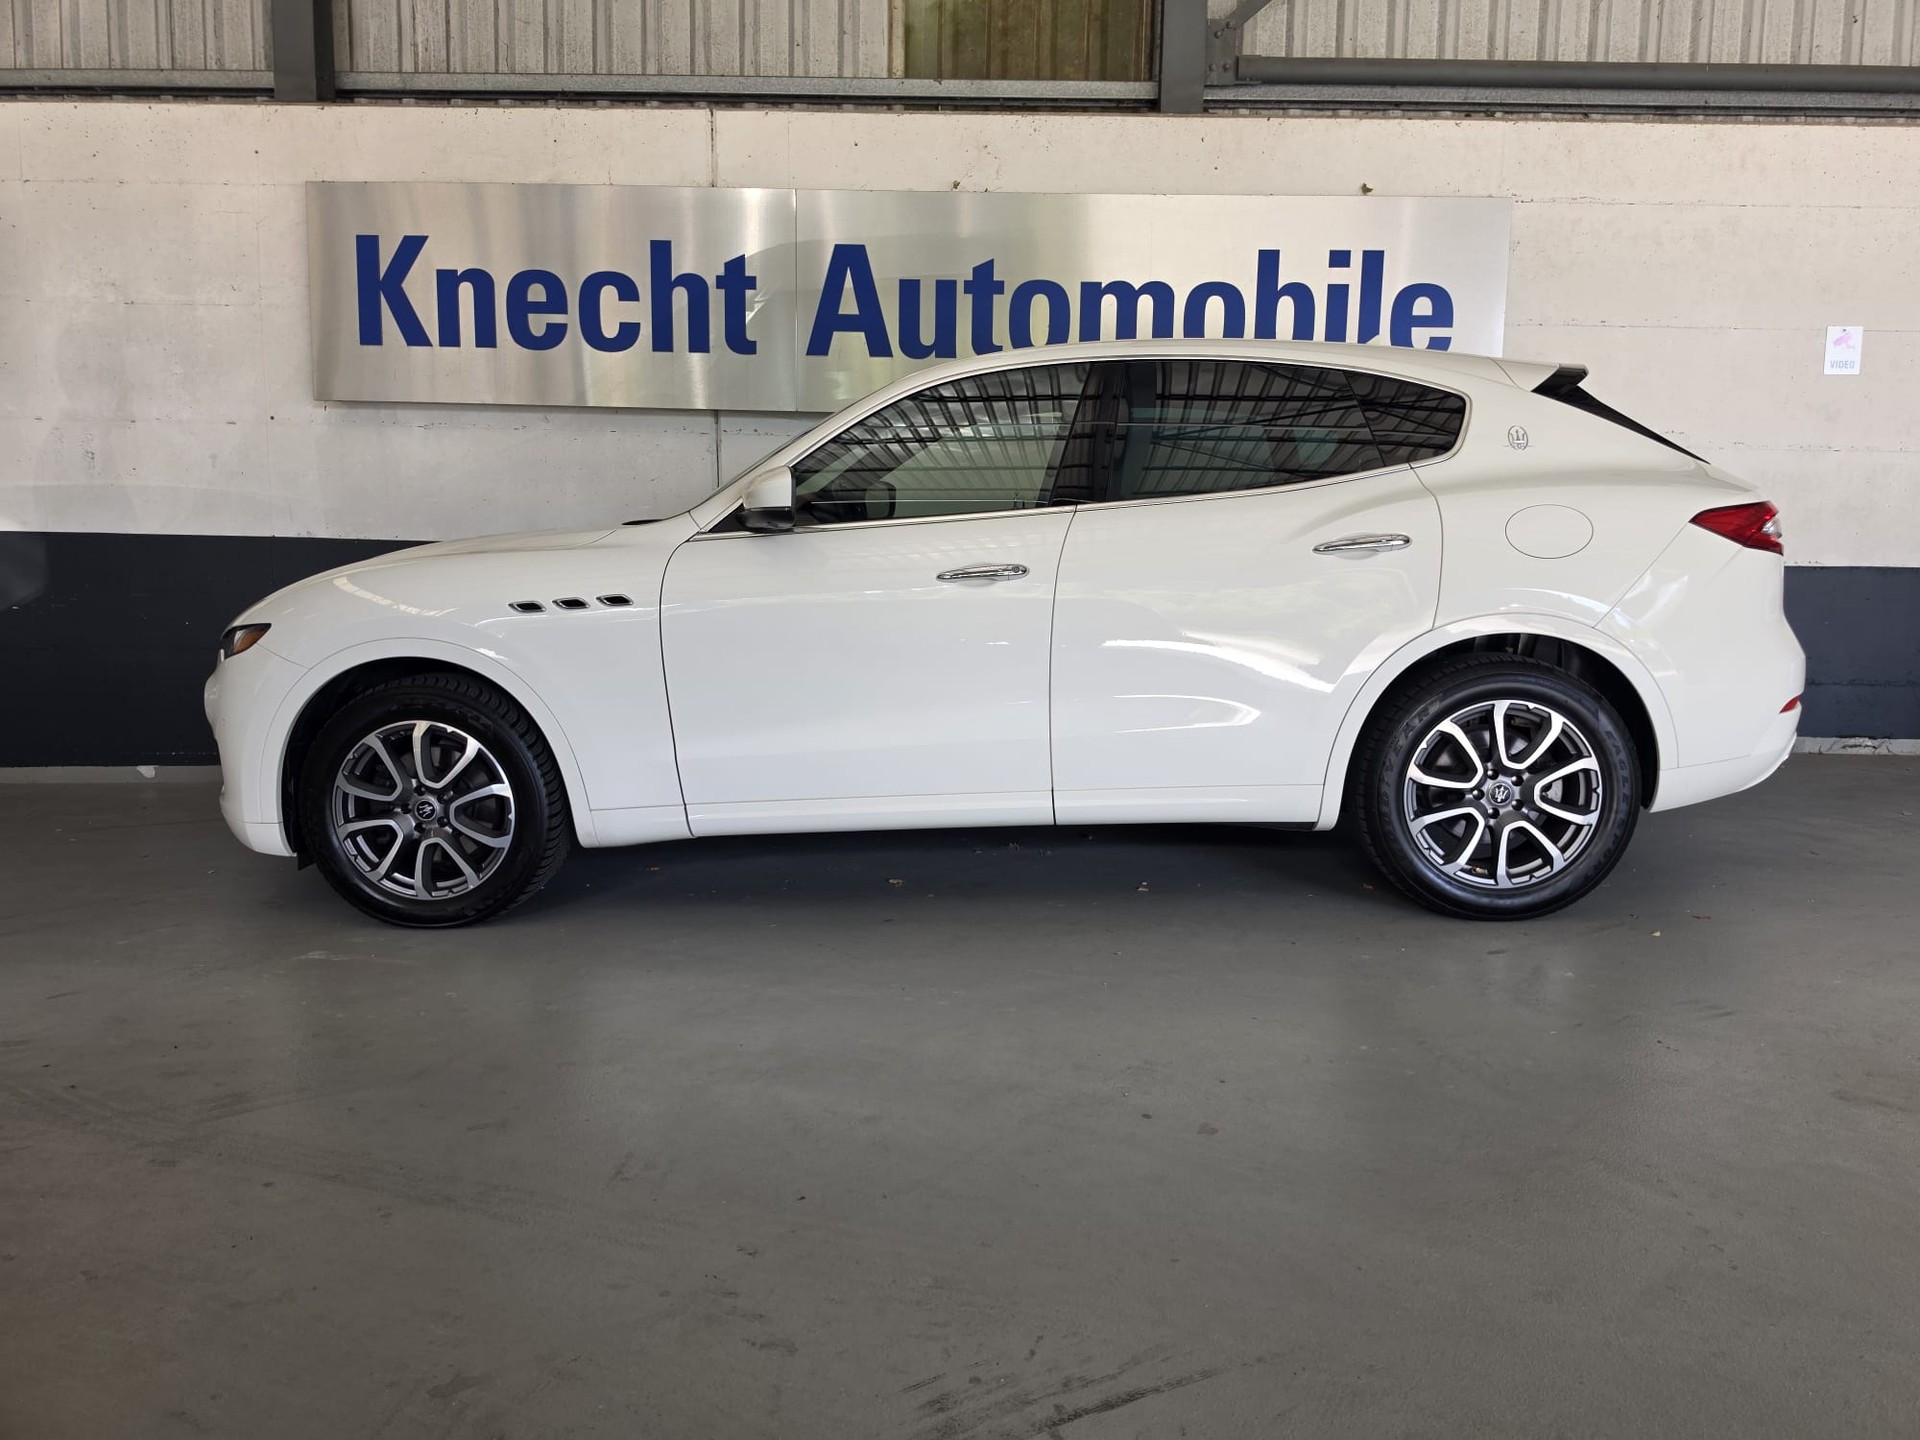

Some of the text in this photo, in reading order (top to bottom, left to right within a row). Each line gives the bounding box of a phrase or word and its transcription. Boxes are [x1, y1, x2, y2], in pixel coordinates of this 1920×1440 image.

[355, 234, 1455, 360] Knecht Automobile
[1830, 360, 1855, 369] VIDEO
